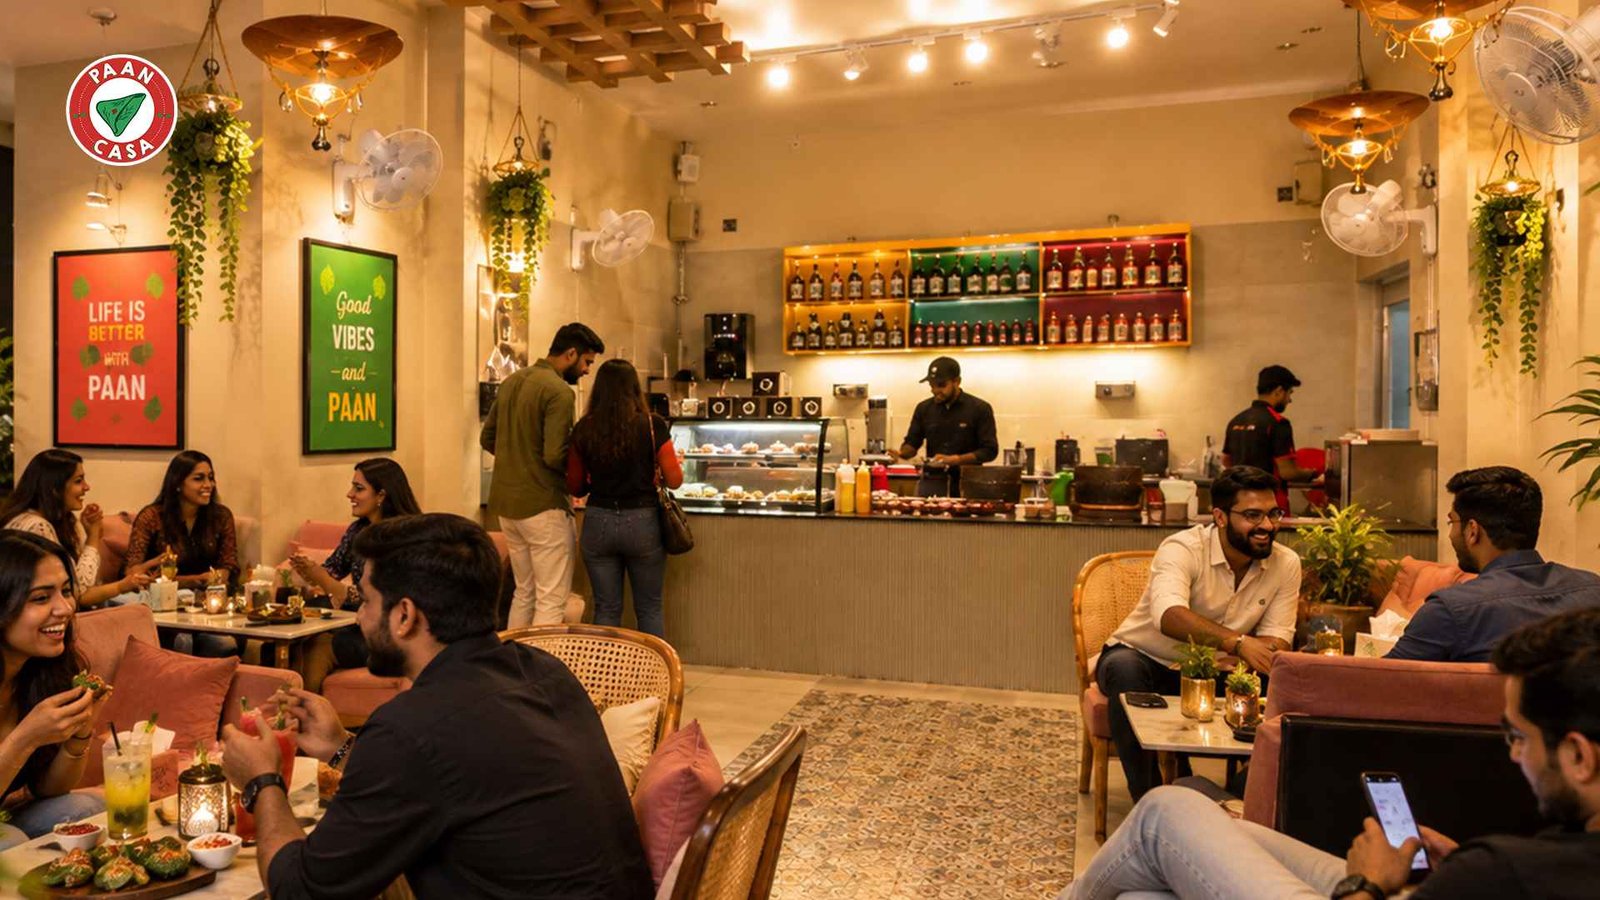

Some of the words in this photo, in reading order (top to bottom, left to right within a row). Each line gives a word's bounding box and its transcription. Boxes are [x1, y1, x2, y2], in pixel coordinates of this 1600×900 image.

[88, 301, 123, 323] LIFE
[129, 300, 145, 321] IS
[336, 291, 372, 320] Good
[88, 324, 145, 341] BETTER
[332, 324, 375, 352] VIBES
[341, 362, 366, 381] and
[88, 374, 145, 400] PAAN
[328, 392, 376, 422] PAAN
